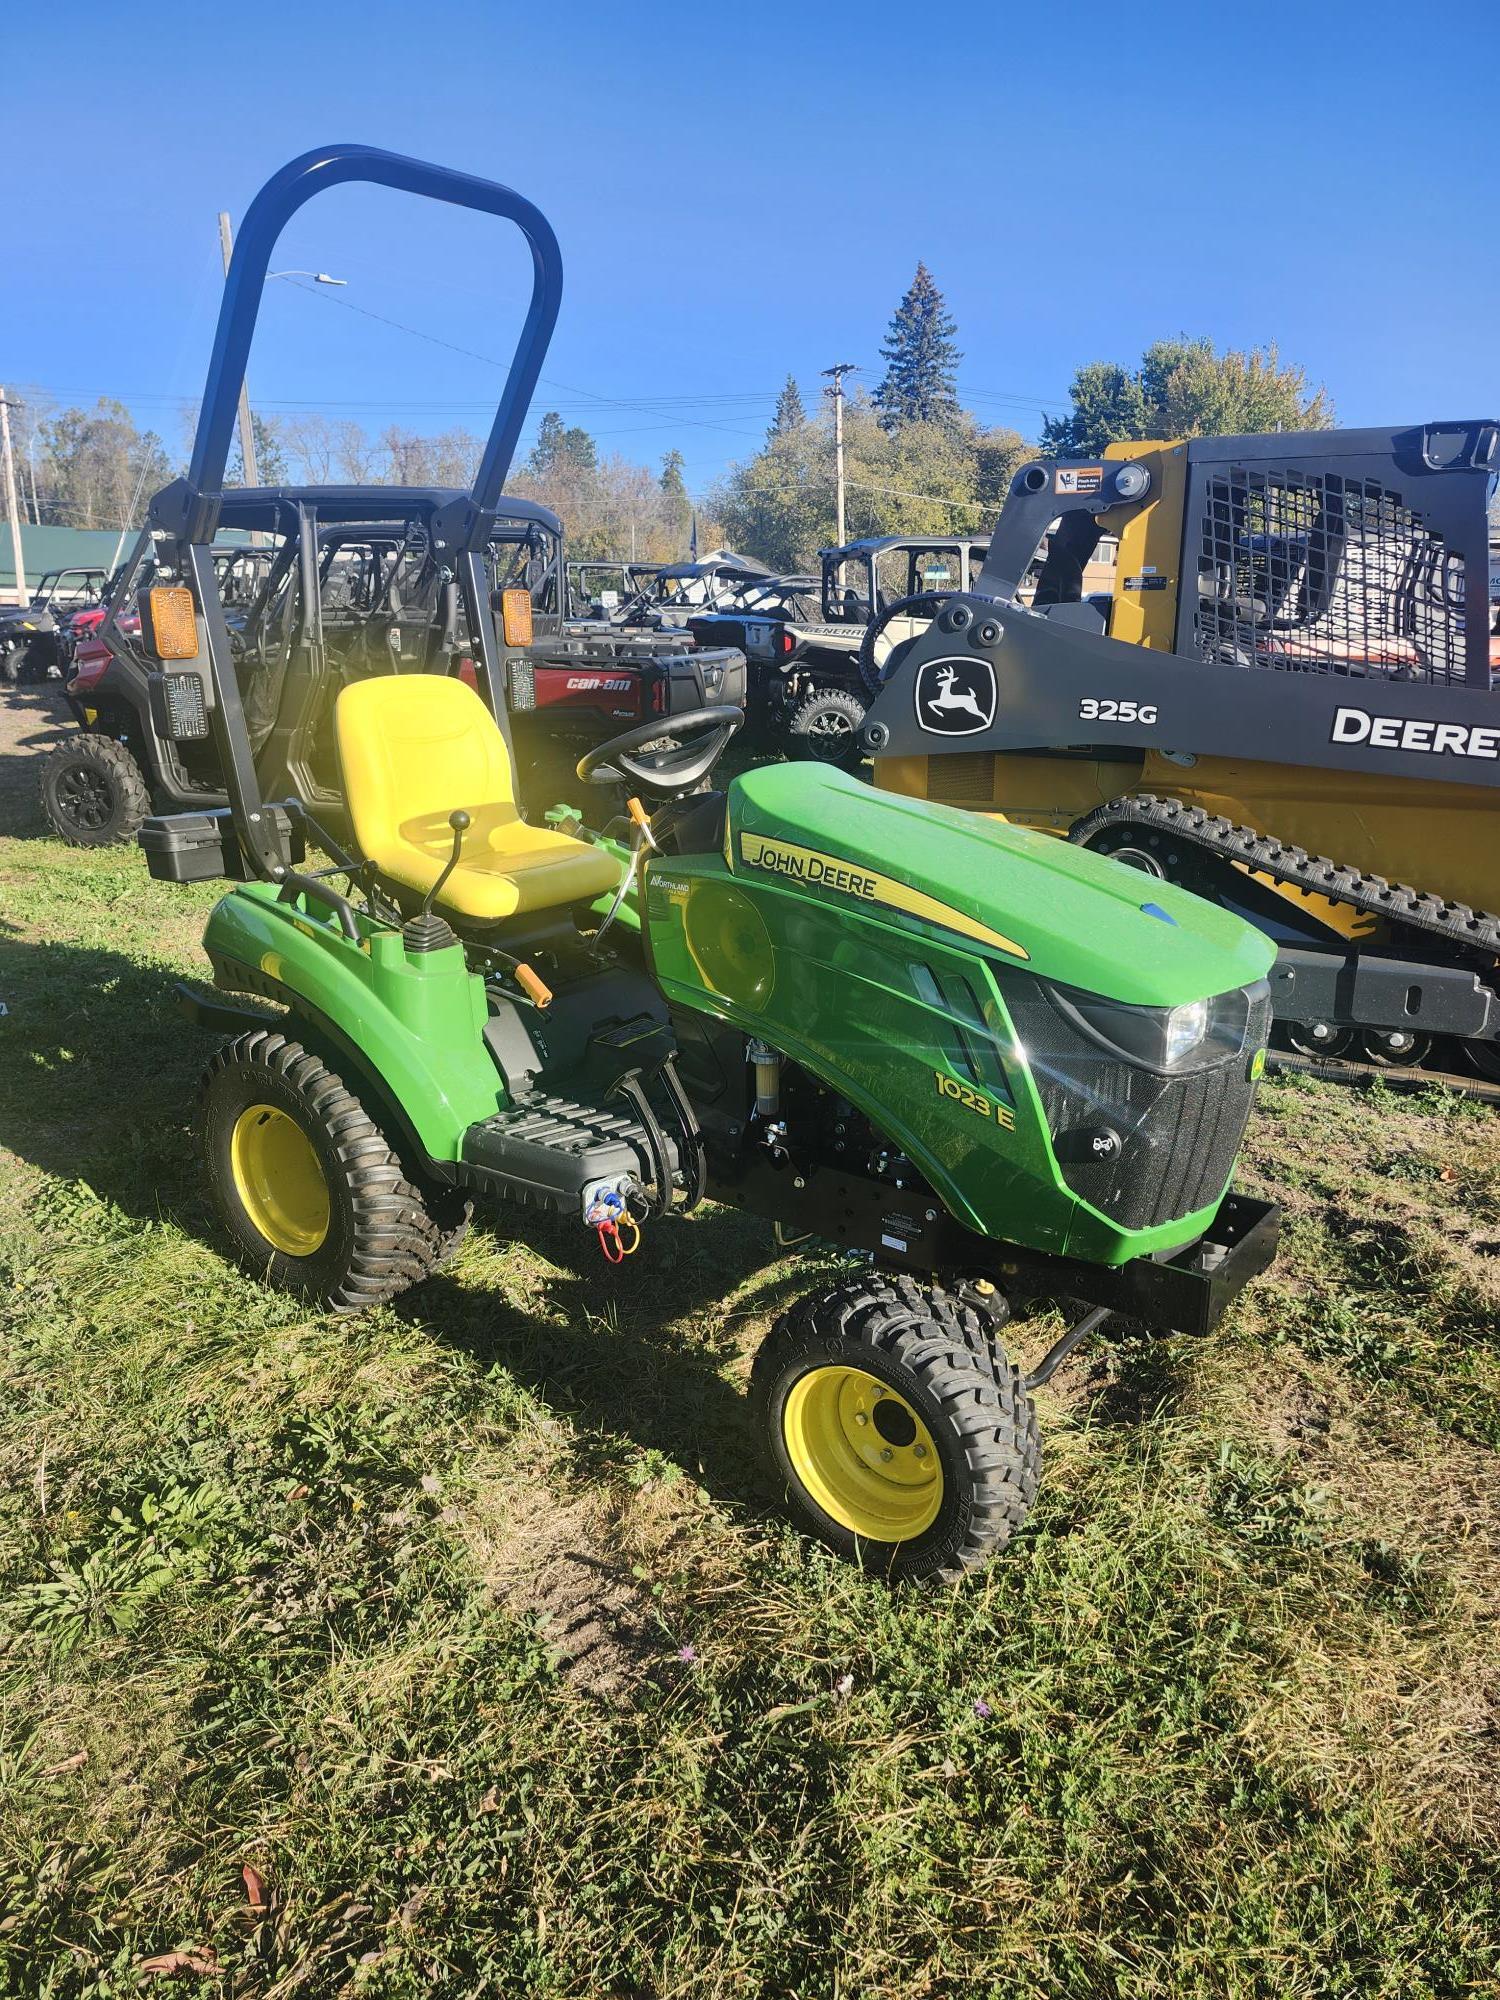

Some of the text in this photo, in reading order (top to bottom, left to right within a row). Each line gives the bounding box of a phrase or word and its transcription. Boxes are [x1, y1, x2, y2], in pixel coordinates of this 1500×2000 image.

[566, 677, 632, 691] can-am
[1079, 698, 1158, 725] 325G
[1332, 707, 1500, 759] DEERE
[650, 874, 690, 892] NORTHLAND
[751, 844, 877, 898] JOHN DEERE
[935, 1071, 1016, 1133] 1023 E
